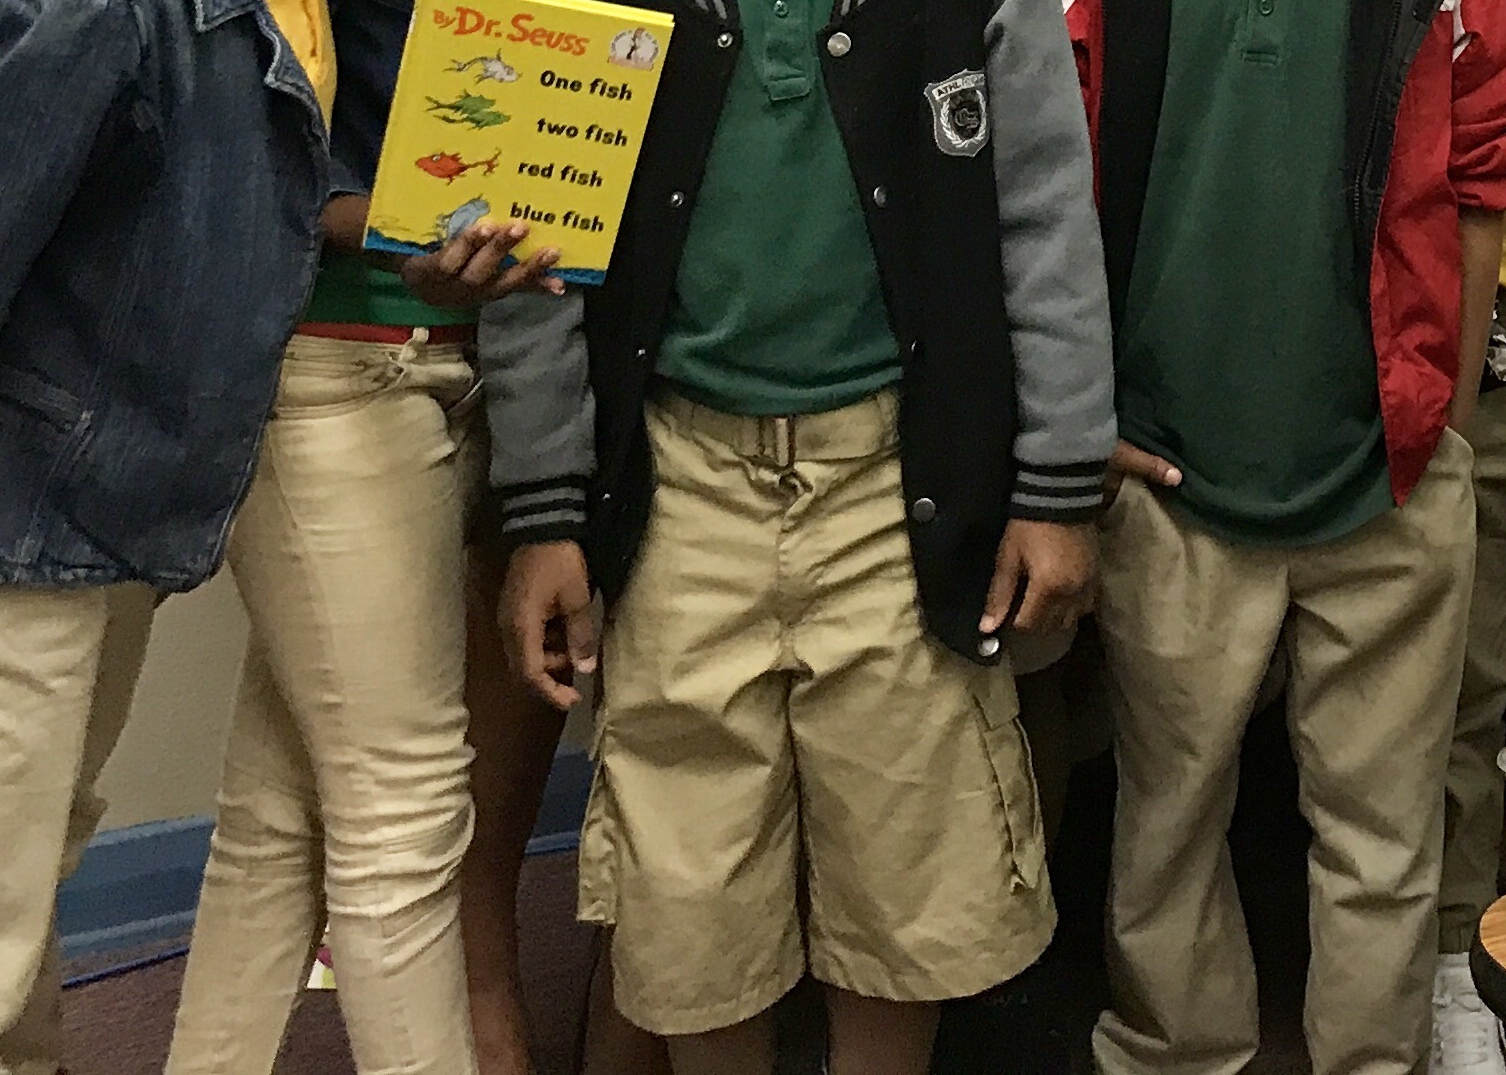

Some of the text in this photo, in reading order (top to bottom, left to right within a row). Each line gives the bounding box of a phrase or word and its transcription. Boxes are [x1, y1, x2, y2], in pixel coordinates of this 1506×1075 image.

[432, 5, 591, 57] By Dr. Seuss
[539, 69, 633, 102] One fish
[536, 117, 629, 148] two fish
[517, 160, 604, 189] red fish
[509, 201, 605, 234] blue fish
